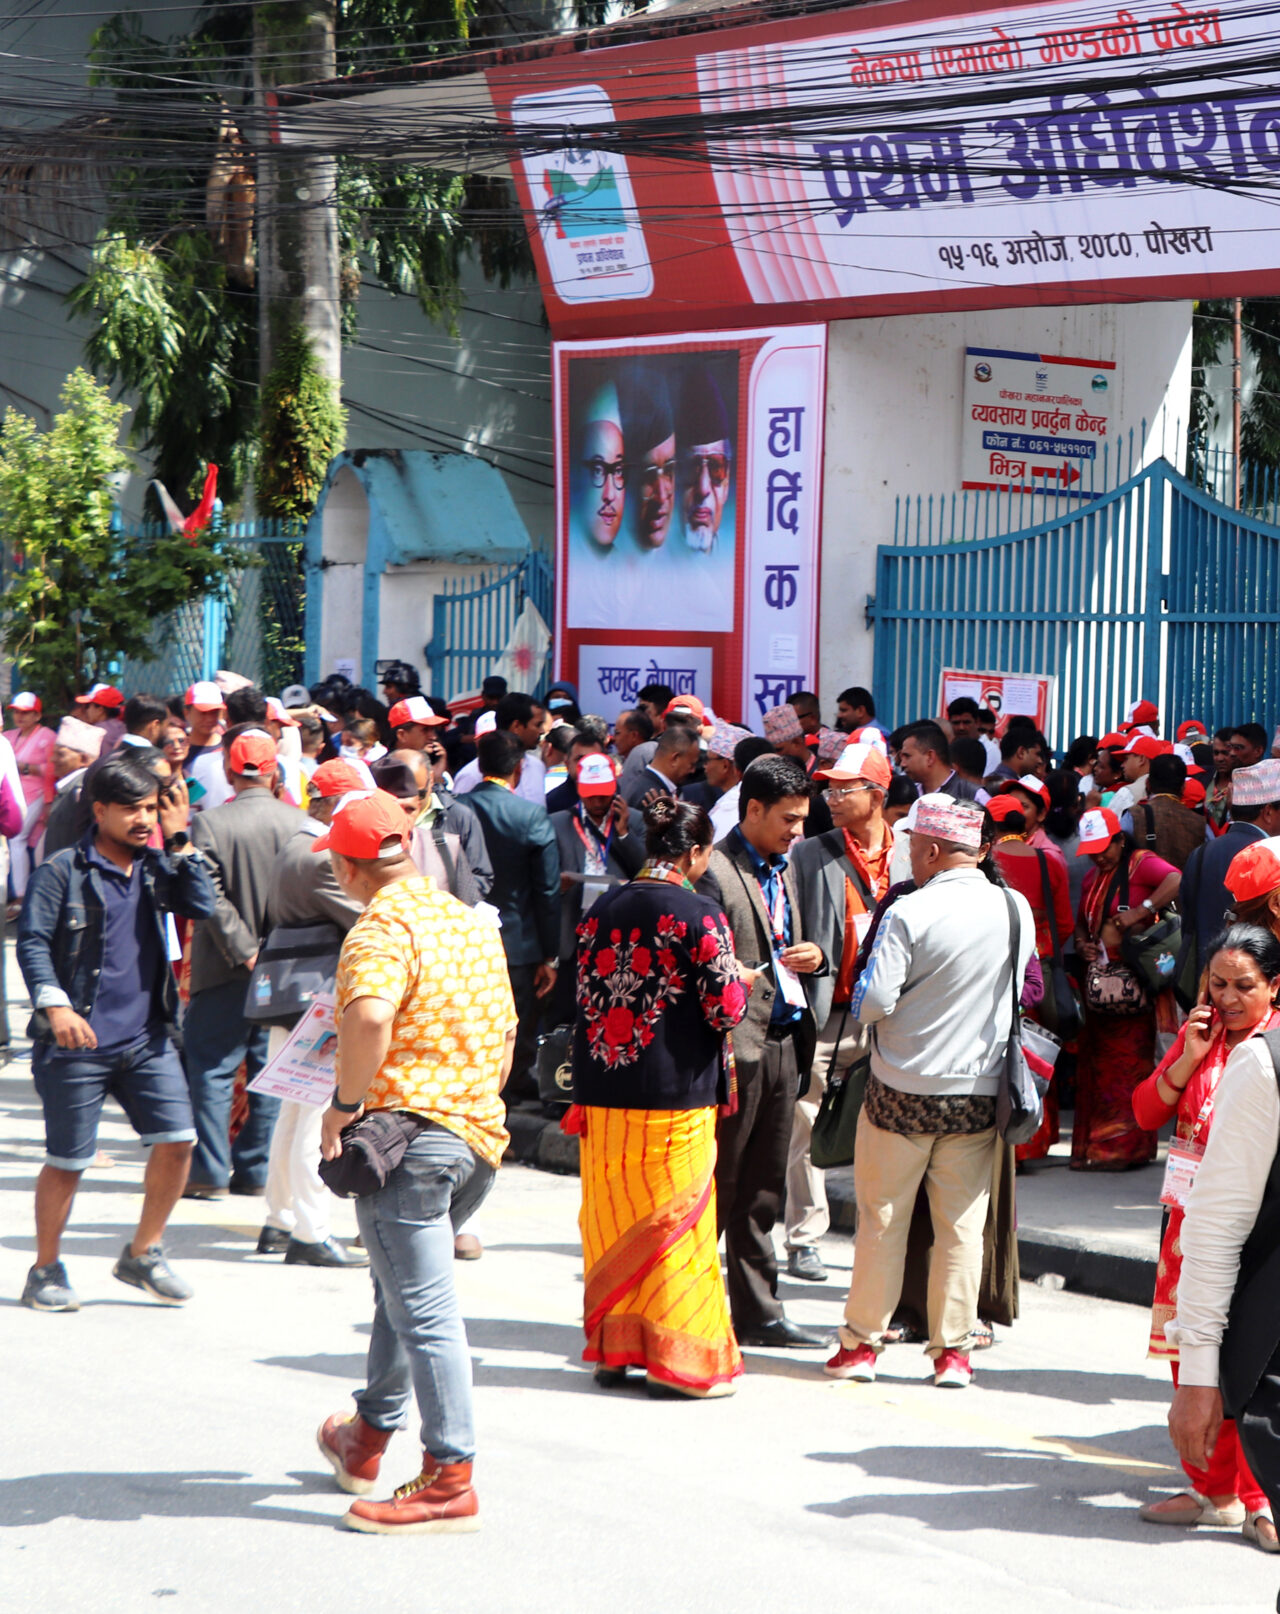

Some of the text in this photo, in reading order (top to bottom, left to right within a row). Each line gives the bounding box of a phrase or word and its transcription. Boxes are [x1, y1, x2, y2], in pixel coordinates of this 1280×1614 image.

[847, 48, 923, 89] नेकपा
[814, 125, 975, 228] प्रथम
[939, 242, 999, 270] १५-१६
[1144, 220, 1214, 255] पोखरा
[971, 404, 1027, 426] व्यवसाय
[1075, 409, 1108, 436] केन्द्र
[986, 434, 1008, 447] फोन
[989, 452, 1027, 478] भित्र
